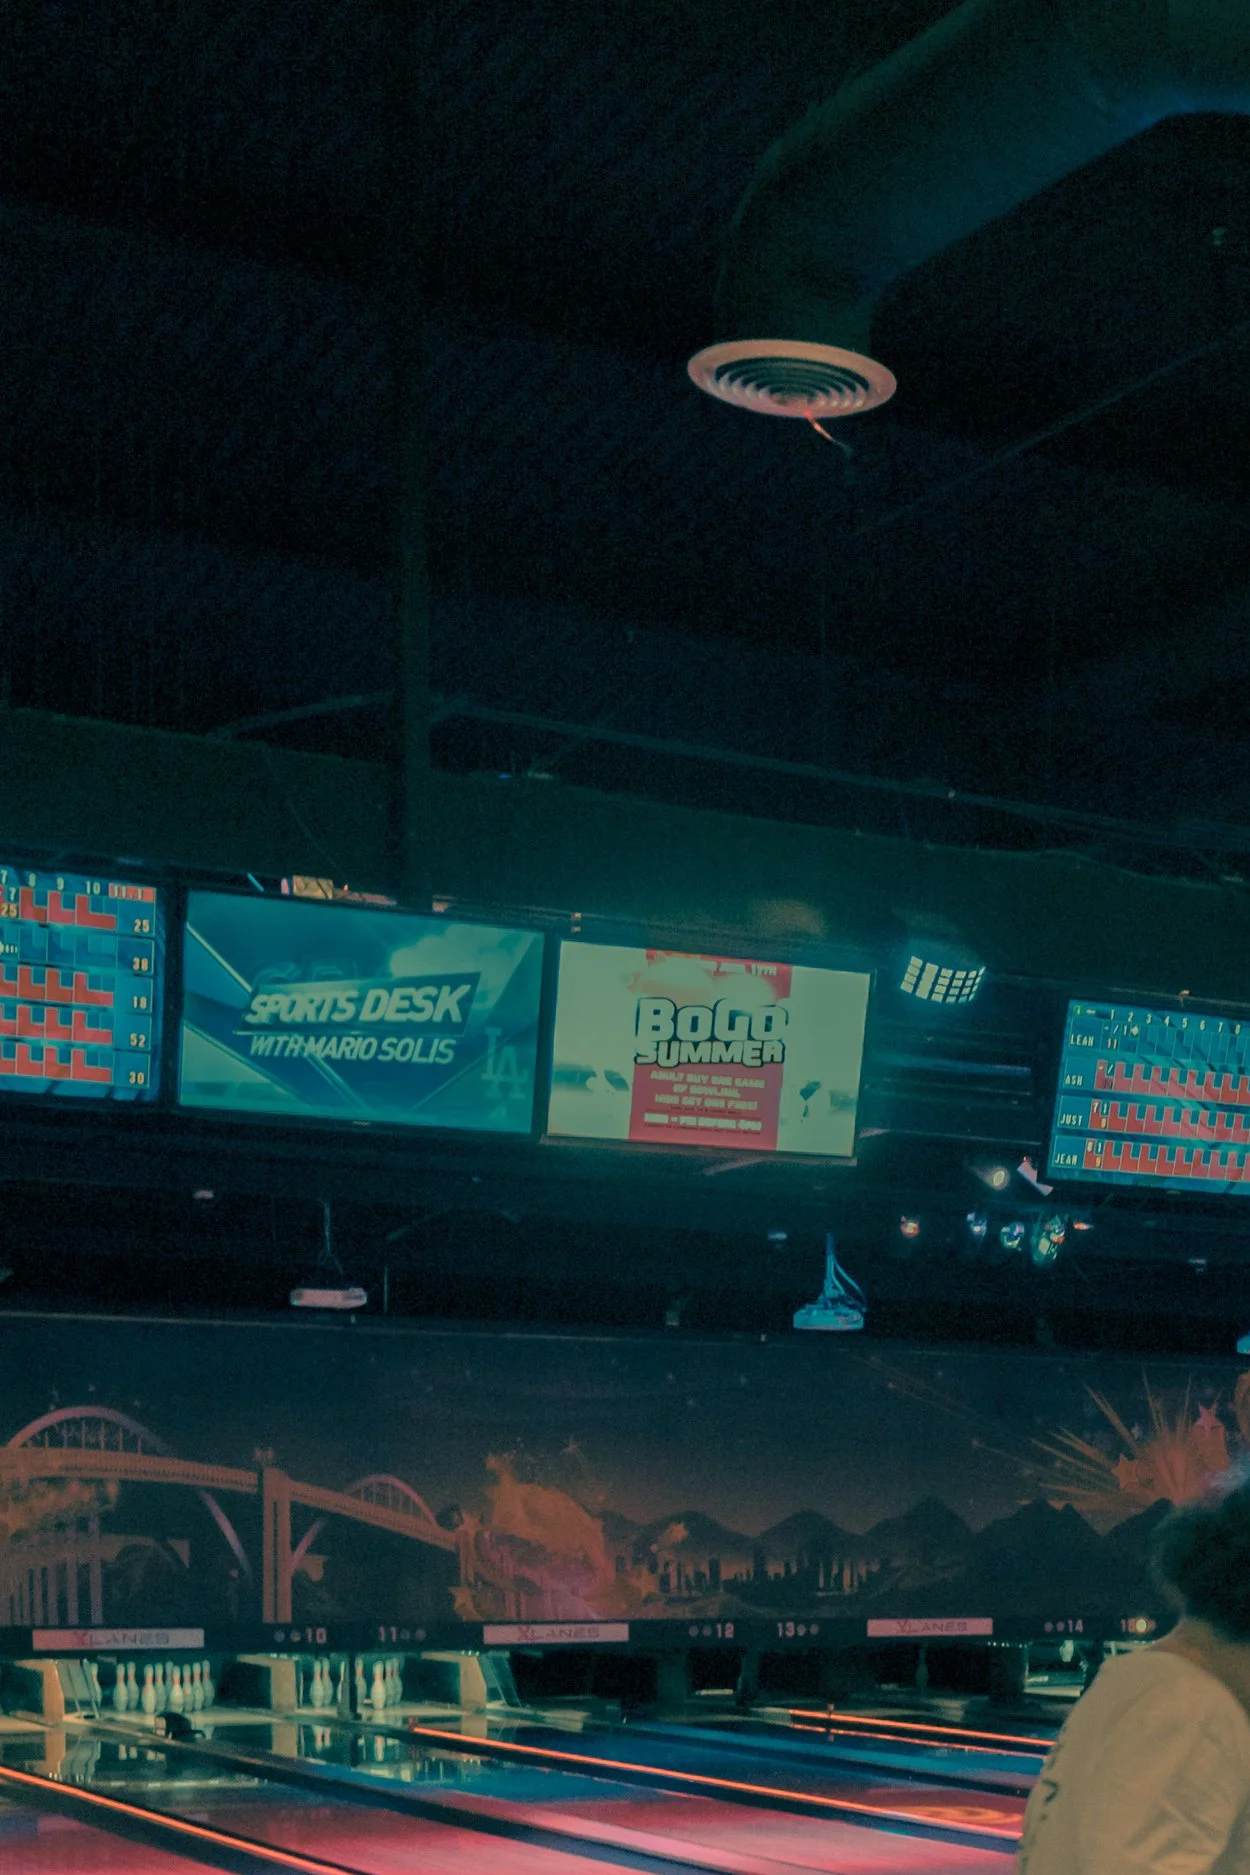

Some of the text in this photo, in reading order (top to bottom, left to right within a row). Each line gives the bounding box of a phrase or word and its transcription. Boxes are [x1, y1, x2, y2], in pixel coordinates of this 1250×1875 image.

[28, 873, 36, 888] 8
[57, 877, 65, 891] 9
[86, 881, 101, 895] 10
[134, 919, 150, 933] 25
[244, 984, 472, 1024] SPORTS DESK
[636, 996, 789, 1041] BOGO
[130, 1033, 146, 1047] 52
[1070, 1034, 1094, 1047] LEAH
[250, 1035, 457, 1065] WITH MARIO SOLIS
[634, 1039, 786, 1069] SUMMER
[1064, 1074, 1083, 1086] ASH
[1059, 1114, 1083, 1126] JUST
[379, 1626, 397, 1642] 11
[716, 1622, 735, 1639] 12
[776, 1621, 795, 1637] 13
[1067, 1619, 1083, 1633] 14
[306, 1627, 326, 1644] 10
